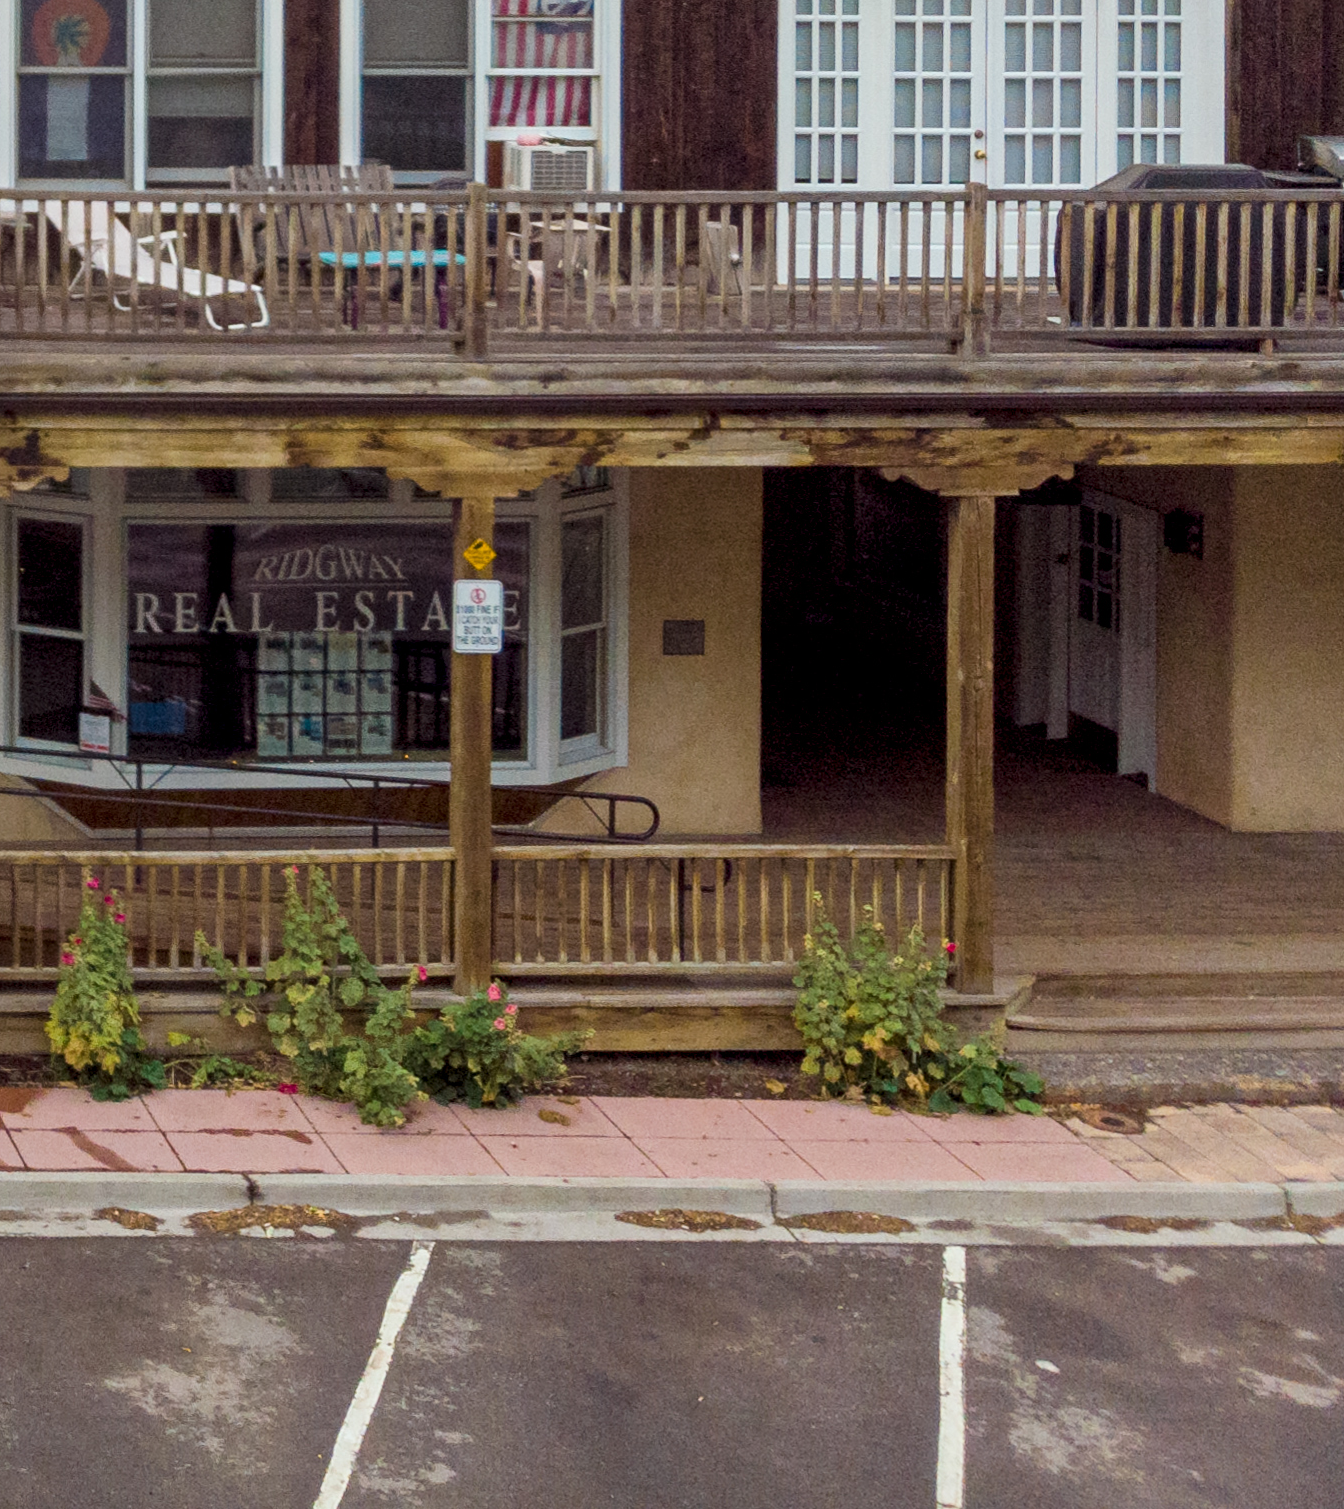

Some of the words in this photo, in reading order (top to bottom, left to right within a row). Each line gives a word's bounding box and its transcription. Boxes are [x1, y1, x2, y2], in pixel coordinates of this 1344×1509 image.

[254, 544, 407, 581] RIDGWAY
[134, 592, 274, 633] REAL
[314, 591, 521, 633] ESTAE
[457, 636, 469, 645] THE
[471, 636, 499, 645] GROUND
[464, 626, 480, 634] BUTT
